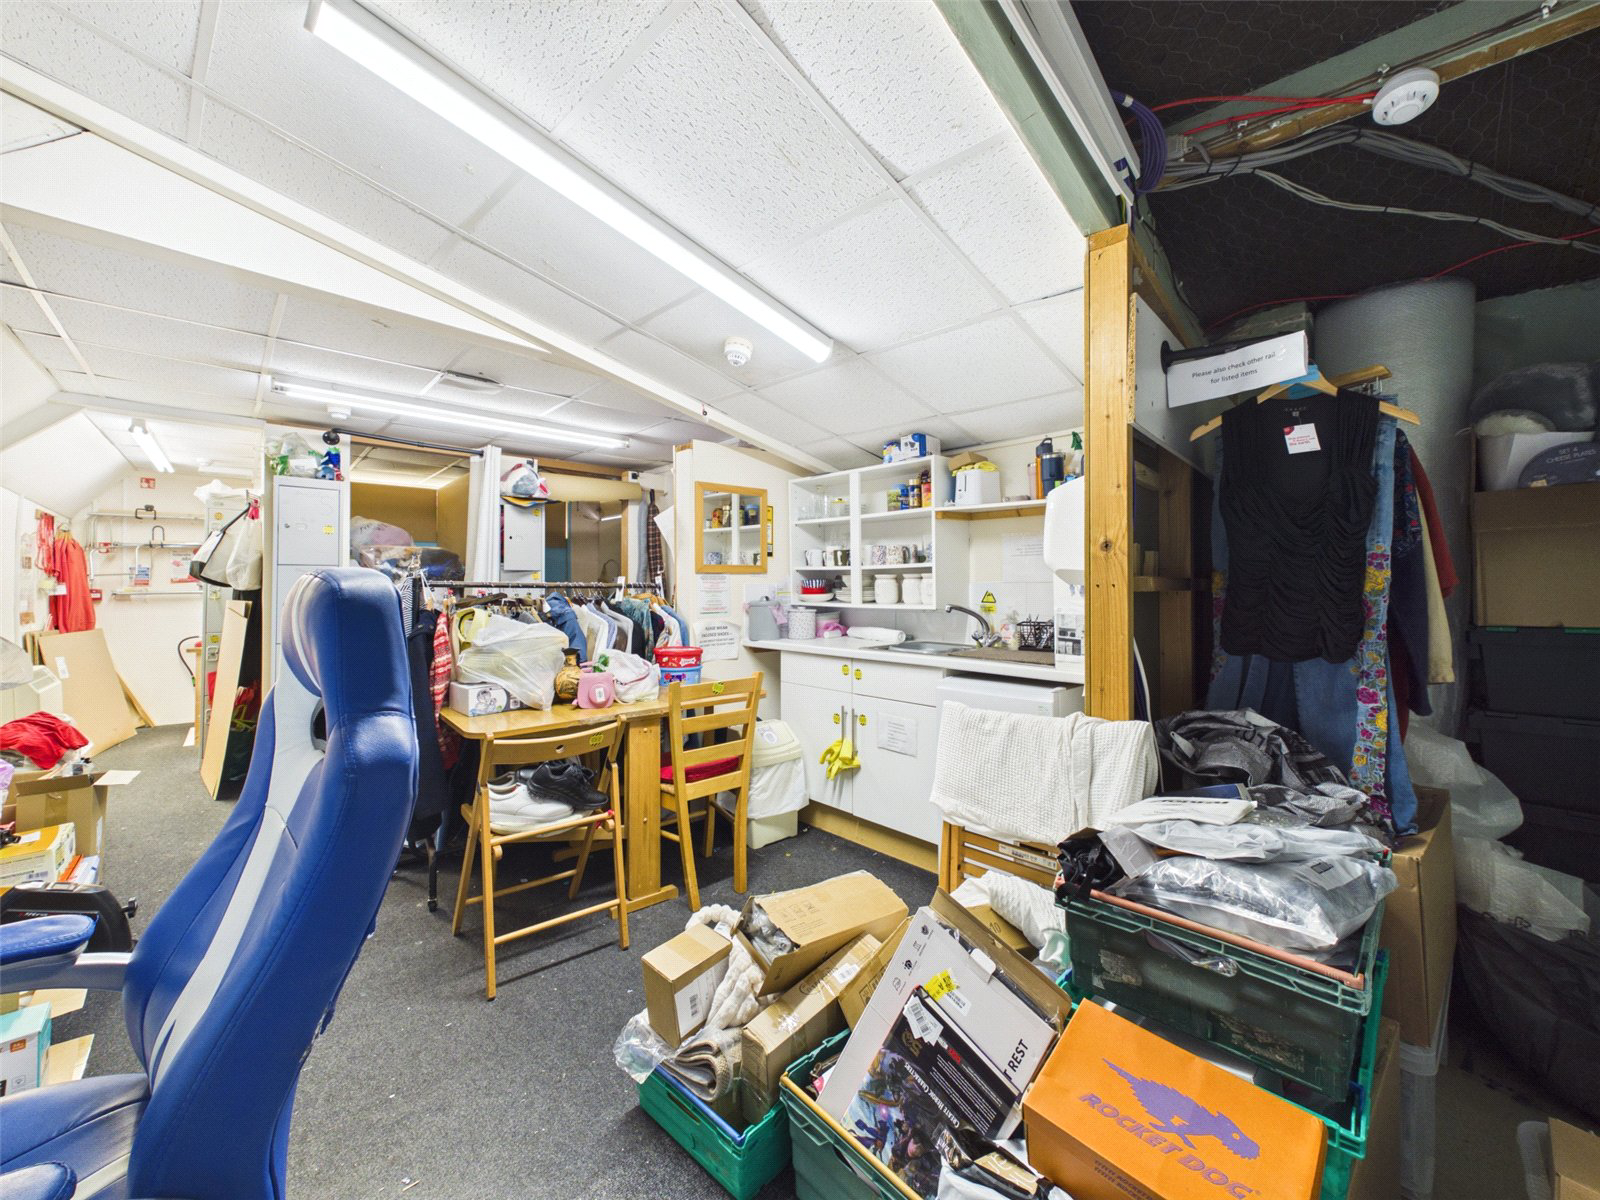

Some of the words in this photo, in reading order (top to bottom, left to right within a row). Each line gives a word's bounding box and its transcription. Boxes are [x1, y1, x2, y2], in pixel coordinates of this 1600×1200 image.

[1191, 368, 1213, 378] Please
[1213, 365, 1227, 374] also
[1227, 361, 1246, 370] check
[1246, 356, 1264, 365] other
[1265, 351, 1276, 360] rail
[1221, 373, 1239, 381] listed
[1240, 369, 1258, 377] items
[1009, 1039, 1029, 1072] REST
[904, 1062, 929, 1093] CHARACTERS
[928, 1089, 944, 1111] HEROIC
[943, 1106, 960, 1128] CREATE
[1079, 1093, 1183, 1154] ROCKET
[1177, 1154, 1253, 1199] DOG
